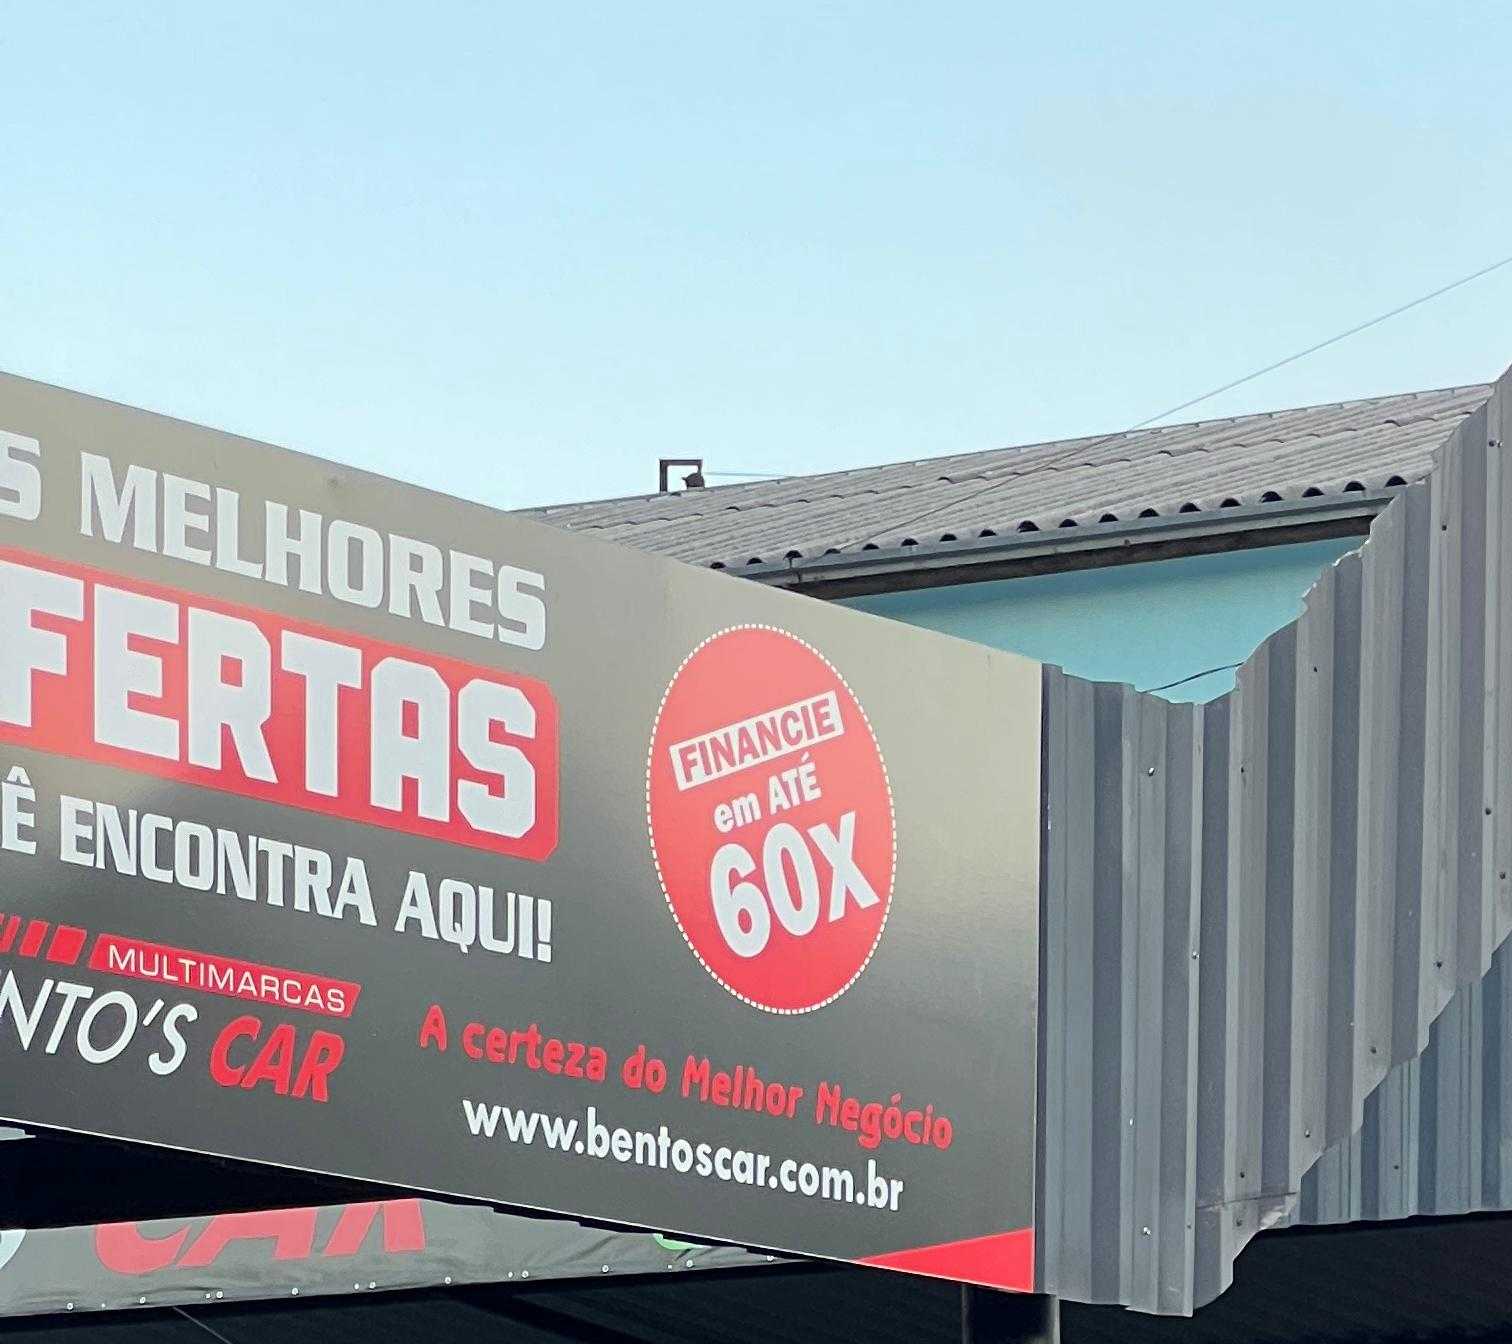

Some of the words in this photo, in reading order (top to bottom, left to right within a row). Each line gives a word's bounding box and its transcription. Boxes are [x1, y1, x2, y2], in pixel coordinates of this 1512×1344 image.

[0, 429, 41, 521] S
[81, 450, 546, 651] MELHORES
[0, 560, 536, 839] FERTAS
[679, 695, 834, 785] FINANCIE
[714, 799, 759, 833] em
[769, 752, 822, 816] ATÉ
[1, 766, 37, 855] Ê
[60, 794, 377, 927] ENCONTRA
[395, 871, 552, 962] AQUI!
[710, 812, 880, 958] 60X
[0, 969, 198, 1076] NTO'S
[209, 1015, 345, 1102] CAR
[108, 944, 346, 1014] MULTIMARCAS
[420, 1005, 446, 1051] A
[463, 1018, 607, 1083] certeza
[623, 1045, 667, 1093] do
[683, 1055, 804, 1116] Melhor
[816, 1081, 953, 1151] Negócio
[463, 1099, 903, 1212] www.bentoscar.com.br
